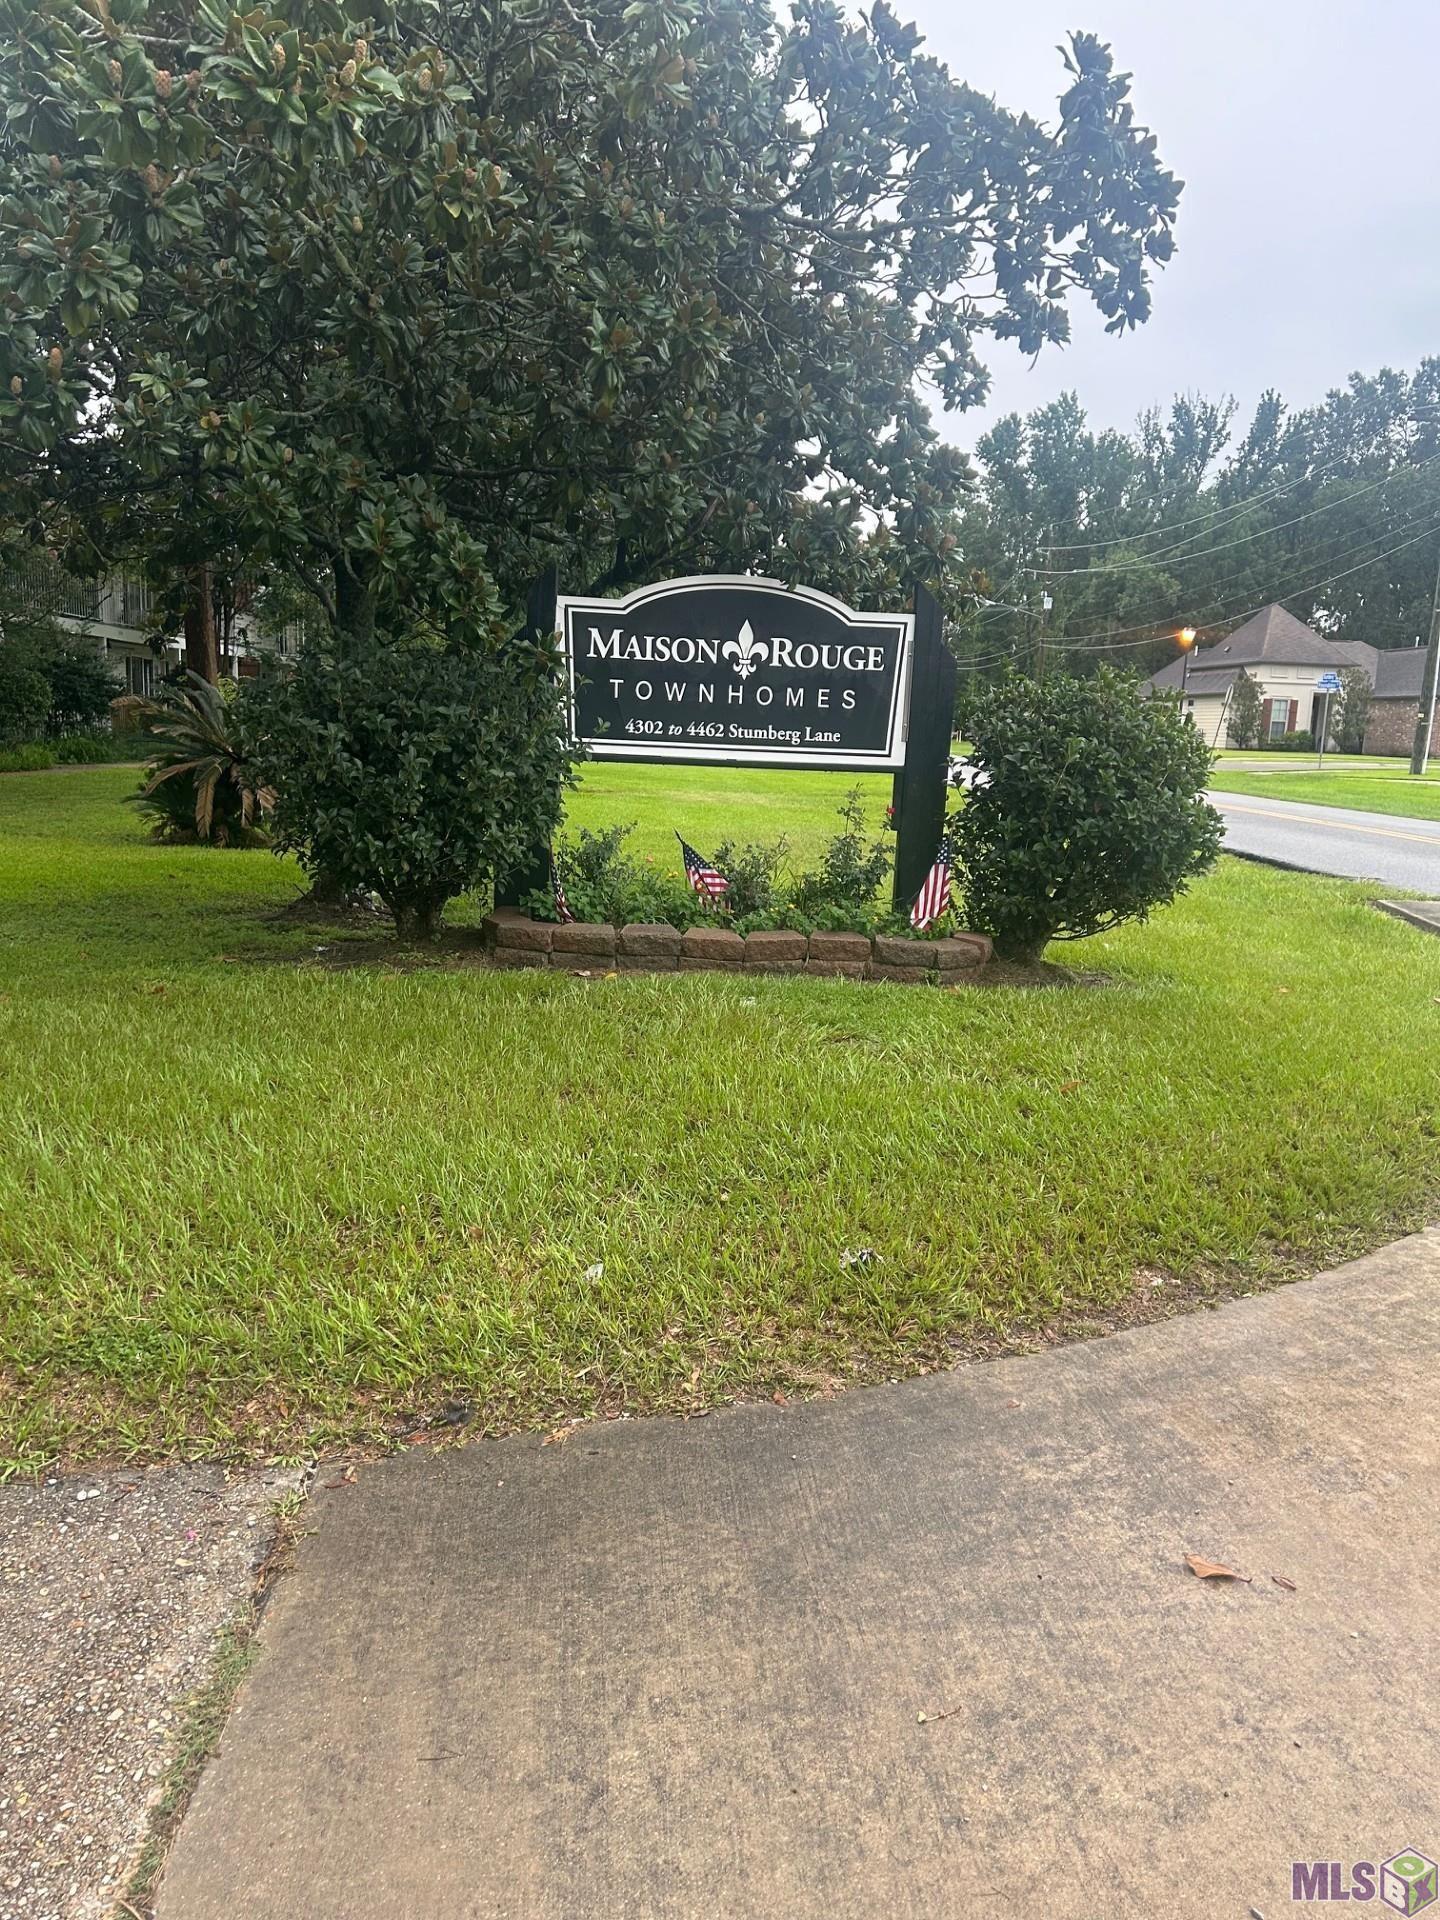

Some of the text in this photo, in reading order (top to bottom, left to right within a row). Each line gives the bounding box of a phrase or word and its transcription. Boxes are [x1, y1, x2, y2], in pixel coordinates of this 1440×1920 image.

[587, 627, 885, 672] MAISON ROUGE
[610, 679, 857, 709] TOWNHOMES
[625, 719, 841, 744] 4302 to 4462 Stumberg Lane
